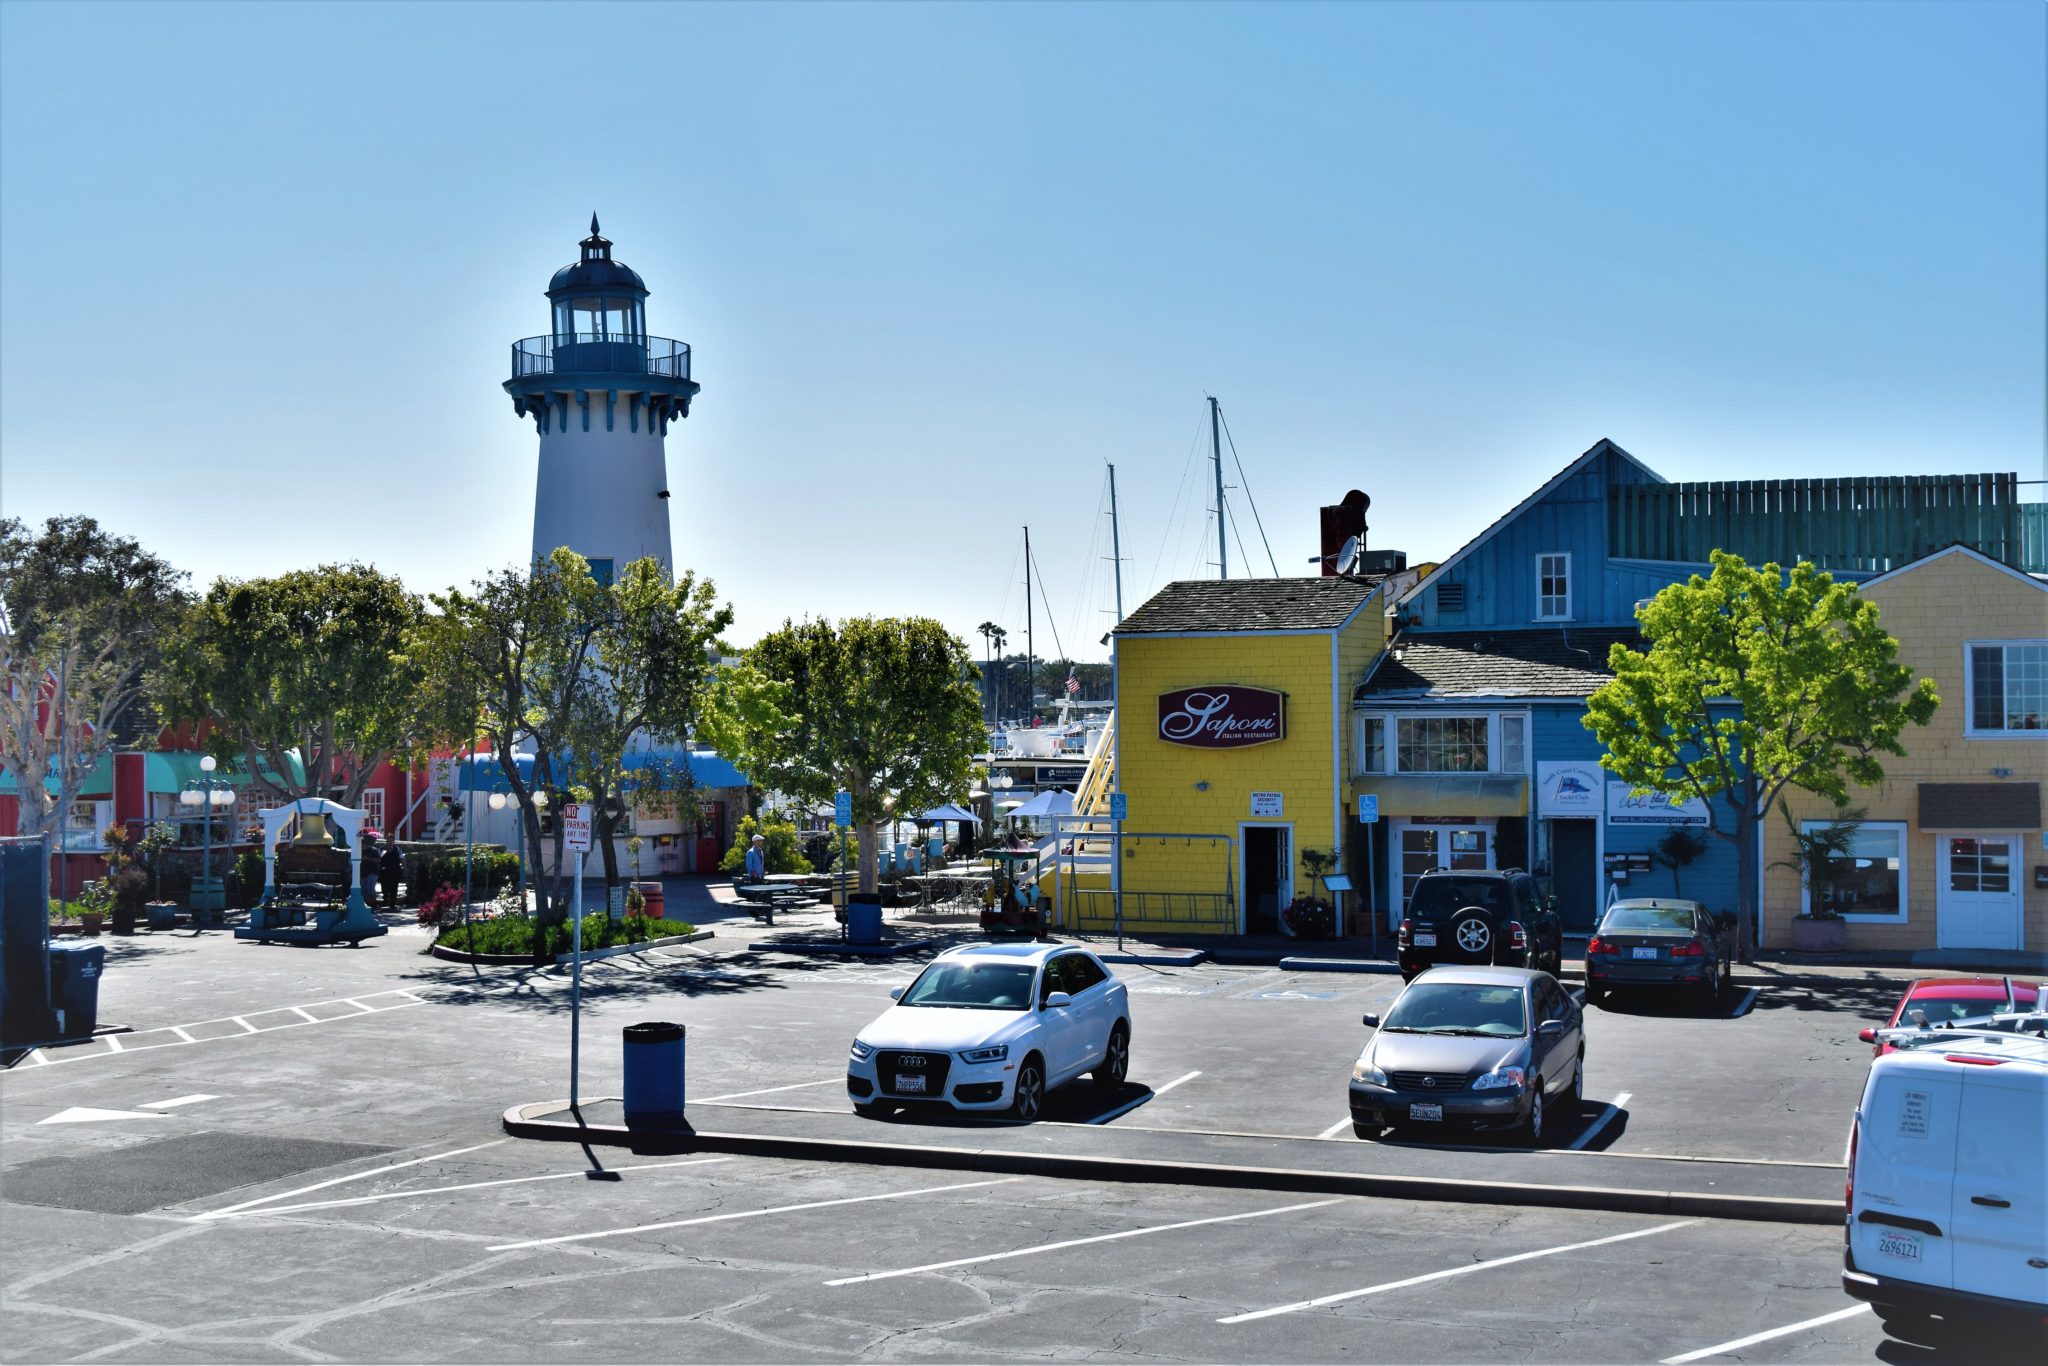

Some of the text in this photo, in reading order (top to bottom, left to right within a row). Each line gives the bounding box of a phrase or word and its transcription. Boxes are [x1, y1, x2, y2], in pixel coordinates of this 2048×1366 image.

[1161, 693, 1277, 739] Sapori
[566, 806, 576, 817] NO
[566, 820, 590, 831] PARKING
[579, 831, 589, 839] TIME
